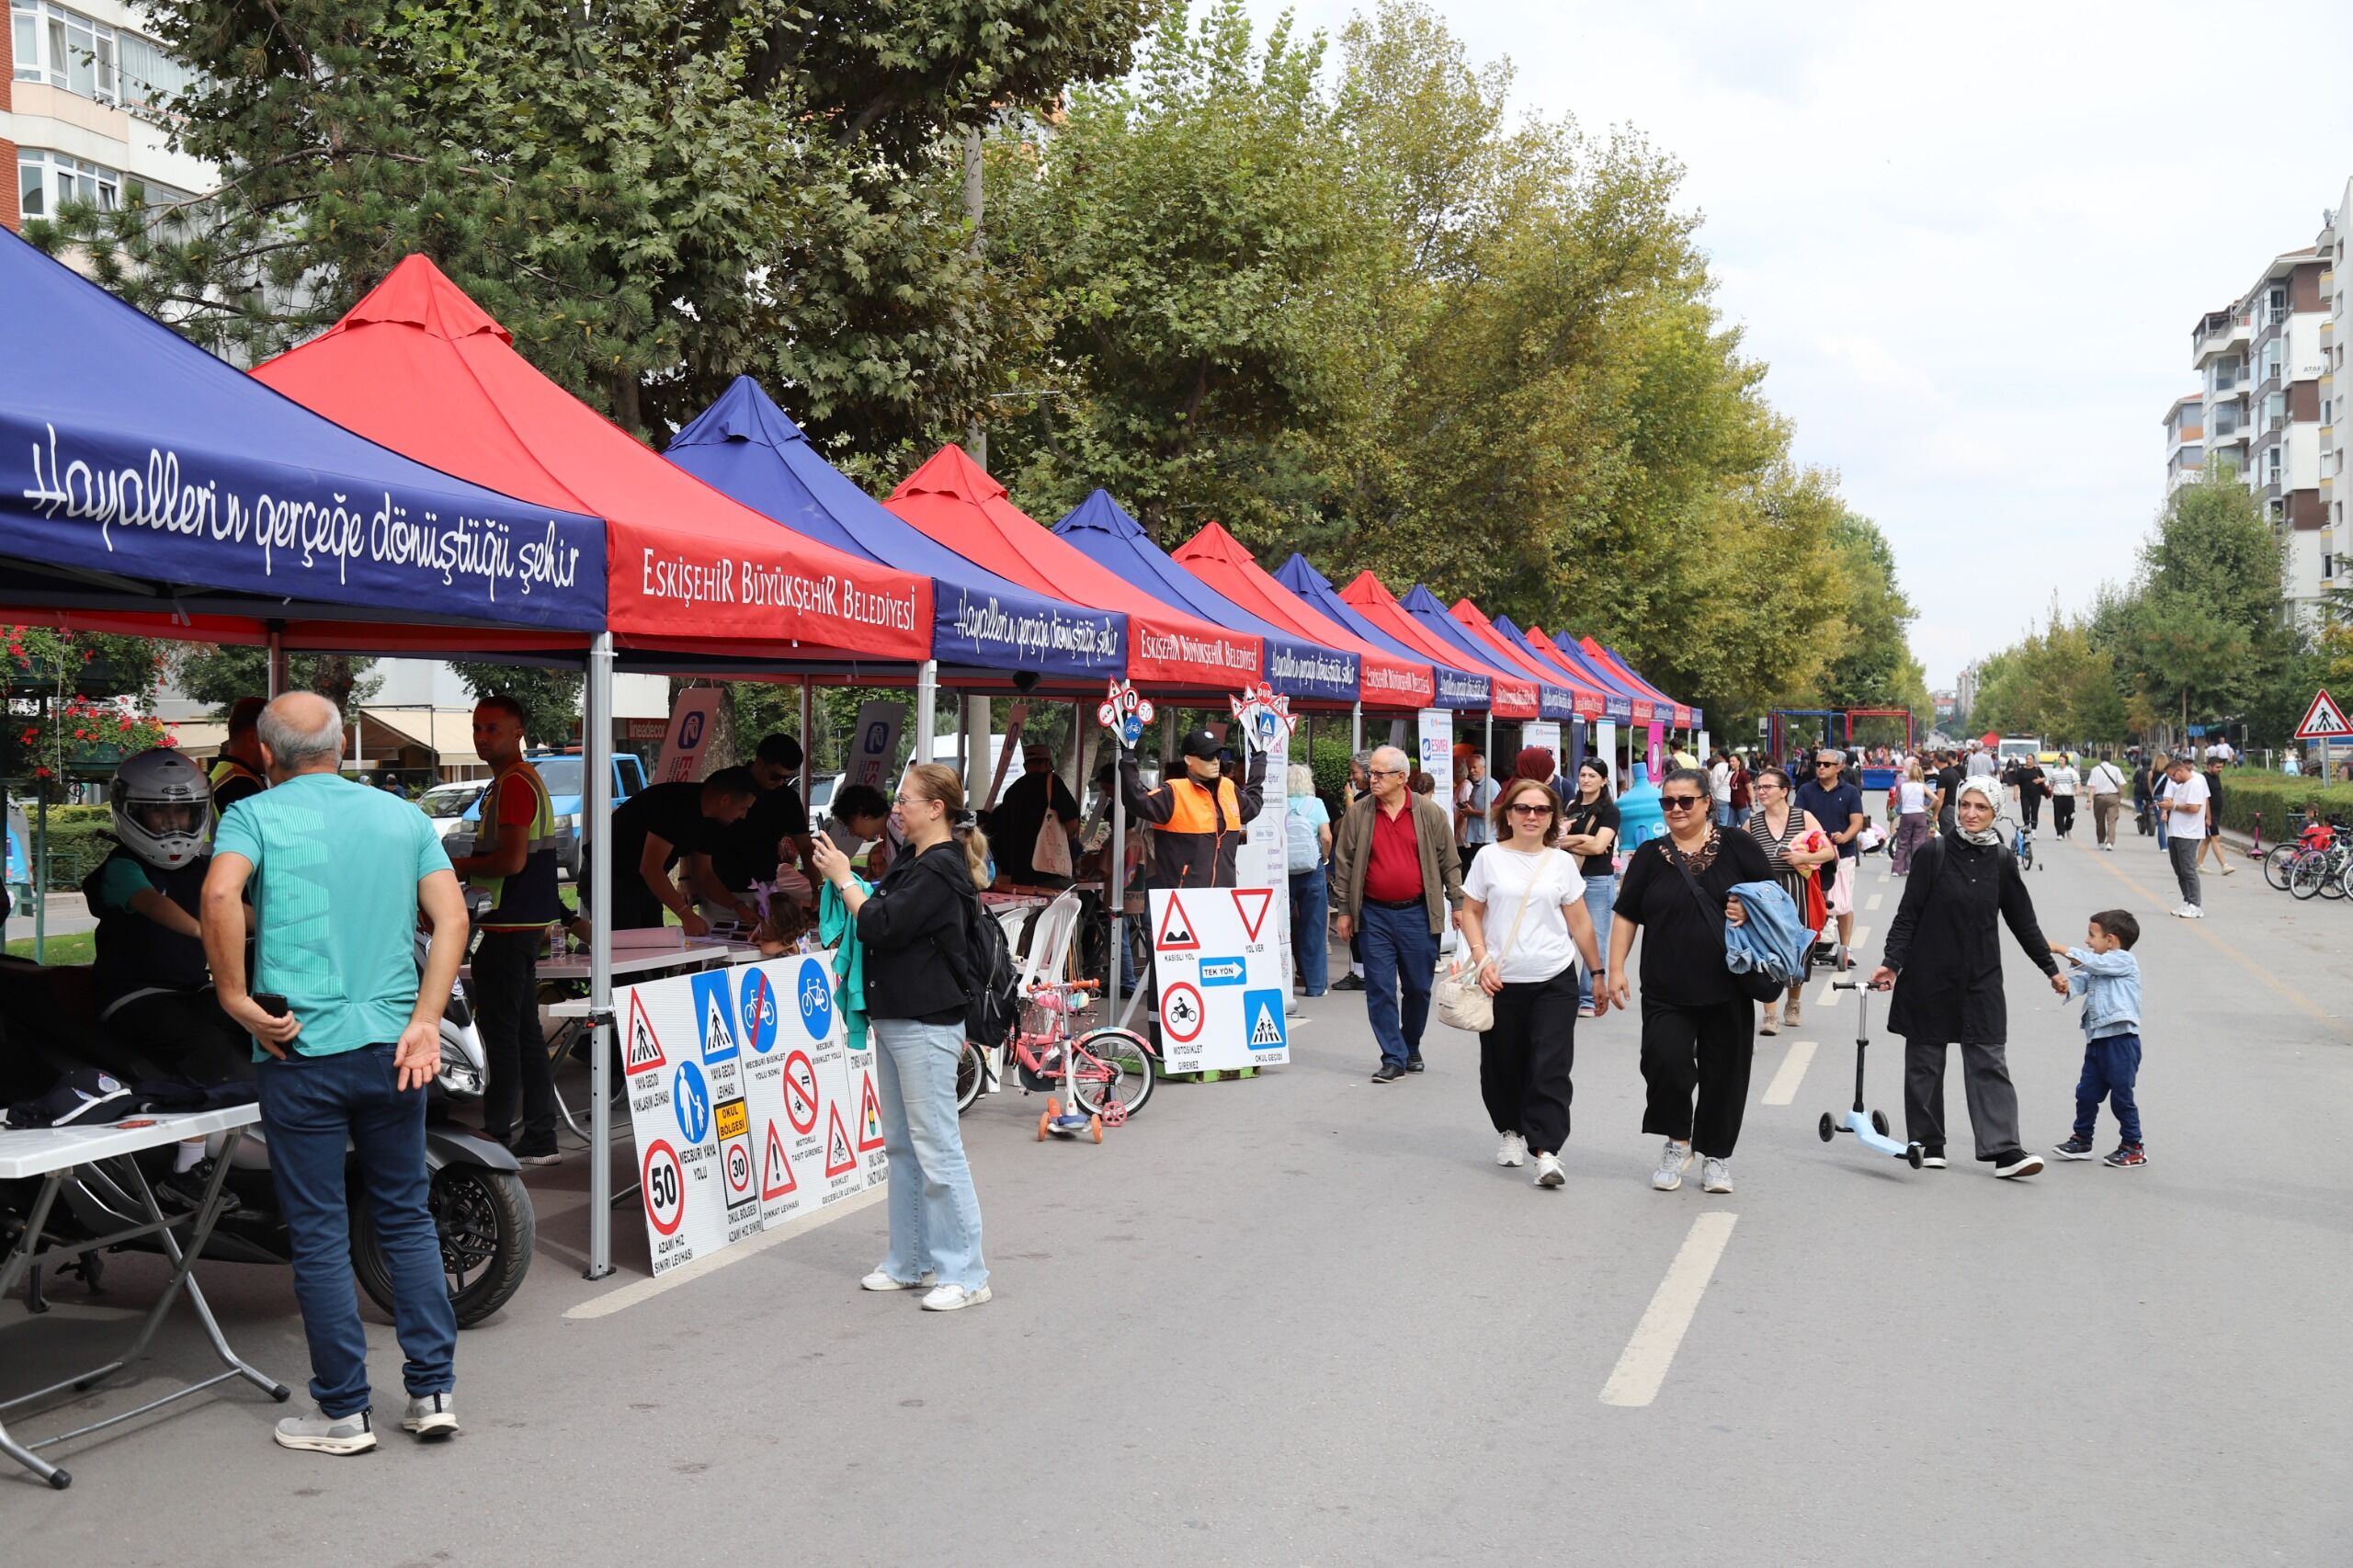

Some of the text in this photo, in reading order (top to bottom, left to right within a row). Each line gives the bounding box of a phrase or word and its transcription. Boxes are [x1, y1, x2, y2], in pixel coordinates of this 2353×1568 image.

[23, 423, 580, 602] Hayallerin gerçeğe dönüştüğü şehir
[953, 588, 1119, 667] Hayallerin gerçeğe dönüştüğü şehir
[1258, 687, 1271, 699] DUR
[1140, 705, 1151, 720] 50
[629, 720, 665, 738] lineadecor
[1245, 944, 1265, 953] YOL VER
[1165, 952, 1195, 962] KASİSLİ YOL
[1204, 967, 1233, 976] TEK YÖN
[815, 1040, 835, 1051] MECBURİ
[1173, 1044, 1203, 1055] MOTOSİKLET
[745, 1057, 766, 1069] MECBURİ
[831, 1051, 842, 1060] YOLU
[1255, 1052, 1283, 1062] OKUL GEÇİDİ
[710, 1066, 722, 1081] YAYA
[1177, 1061, 1199, 1071] GİREMEZ
[755, 1067, 780, 1081] YOLU SONU
[722, 1105, 738, 1119] OKUL
[720, 1118, 745, 1137] BÖLGESİ
[795, 1135, 816, 1148] MOTORLU
[678, 1143, 717, 1165] MECBURİ YAYA
[791, 1145, 824, 1163] TAŞIT GİREMEZ
[693, 1165, 708, 1182] YOLU
[732, 1158, 745, 1178] 30
[652, 1164, 676, 1209] 50
[728, 1203, 757, 1225] OKUL BÖLGESİ
[764, 1199, 800, 1221] DİKKAT LEVHASI
[728, 1224, 742, 1243] AZAMİ
[742, 1223, 750, 1237] HIZ
[658, 1233, 685, 1255] AZAMİ HIZ
[654, 1248, 693, 1275] SINIRI LEVHASI
